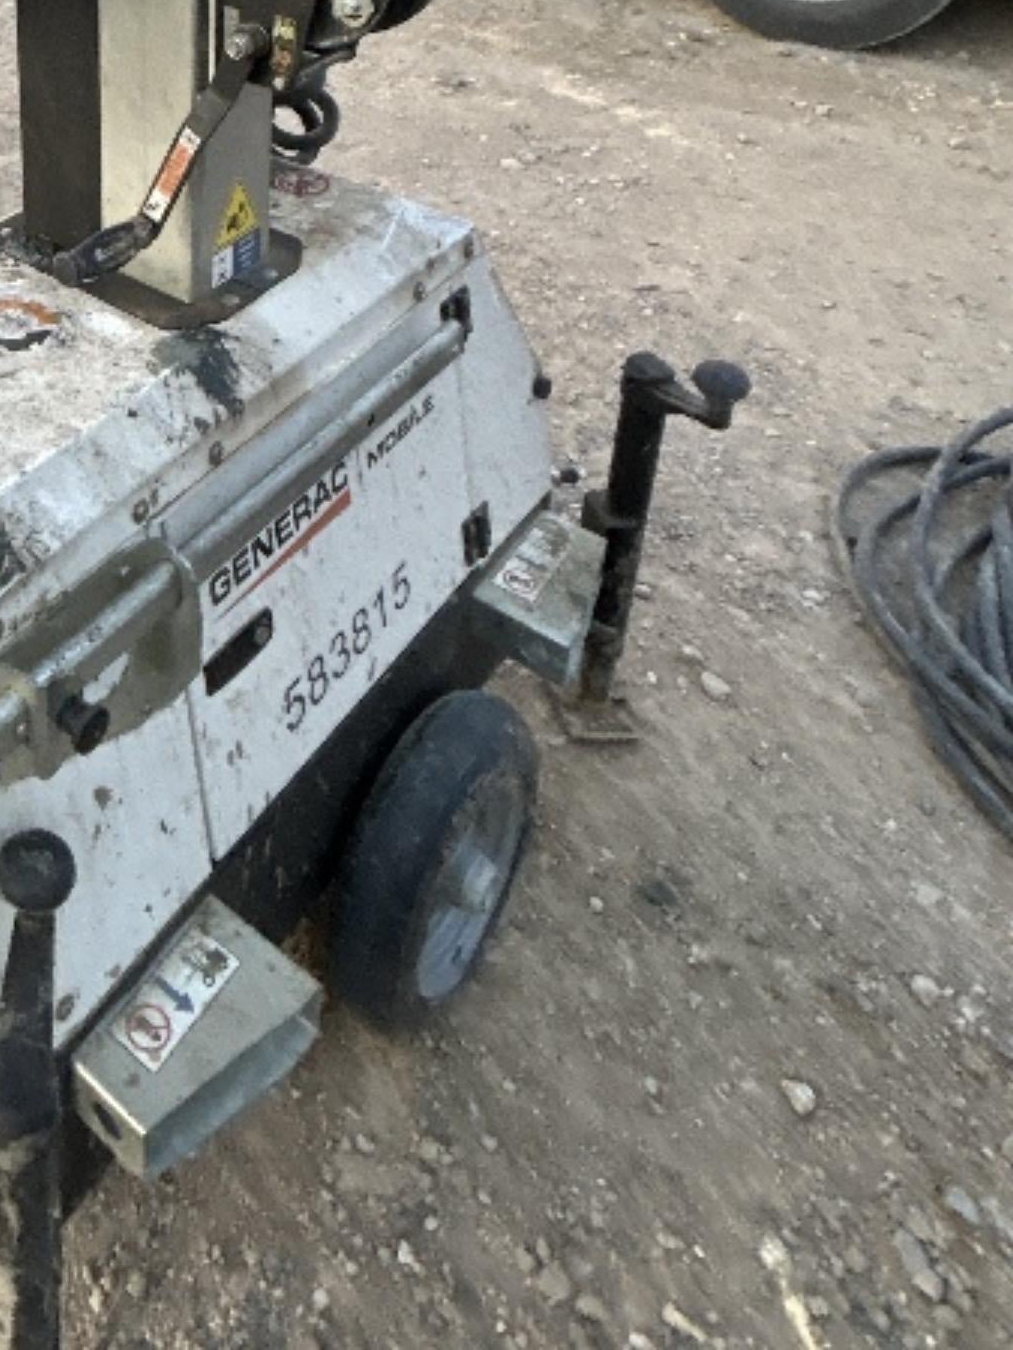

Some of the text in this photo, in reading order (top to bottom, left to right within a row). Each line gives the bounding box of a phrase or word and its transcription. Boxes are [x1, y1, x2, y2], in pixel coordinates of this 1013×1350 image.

[208, 394, 435, 607] GENERAC MOBILE
[283, 561, 412, 733] 583815
